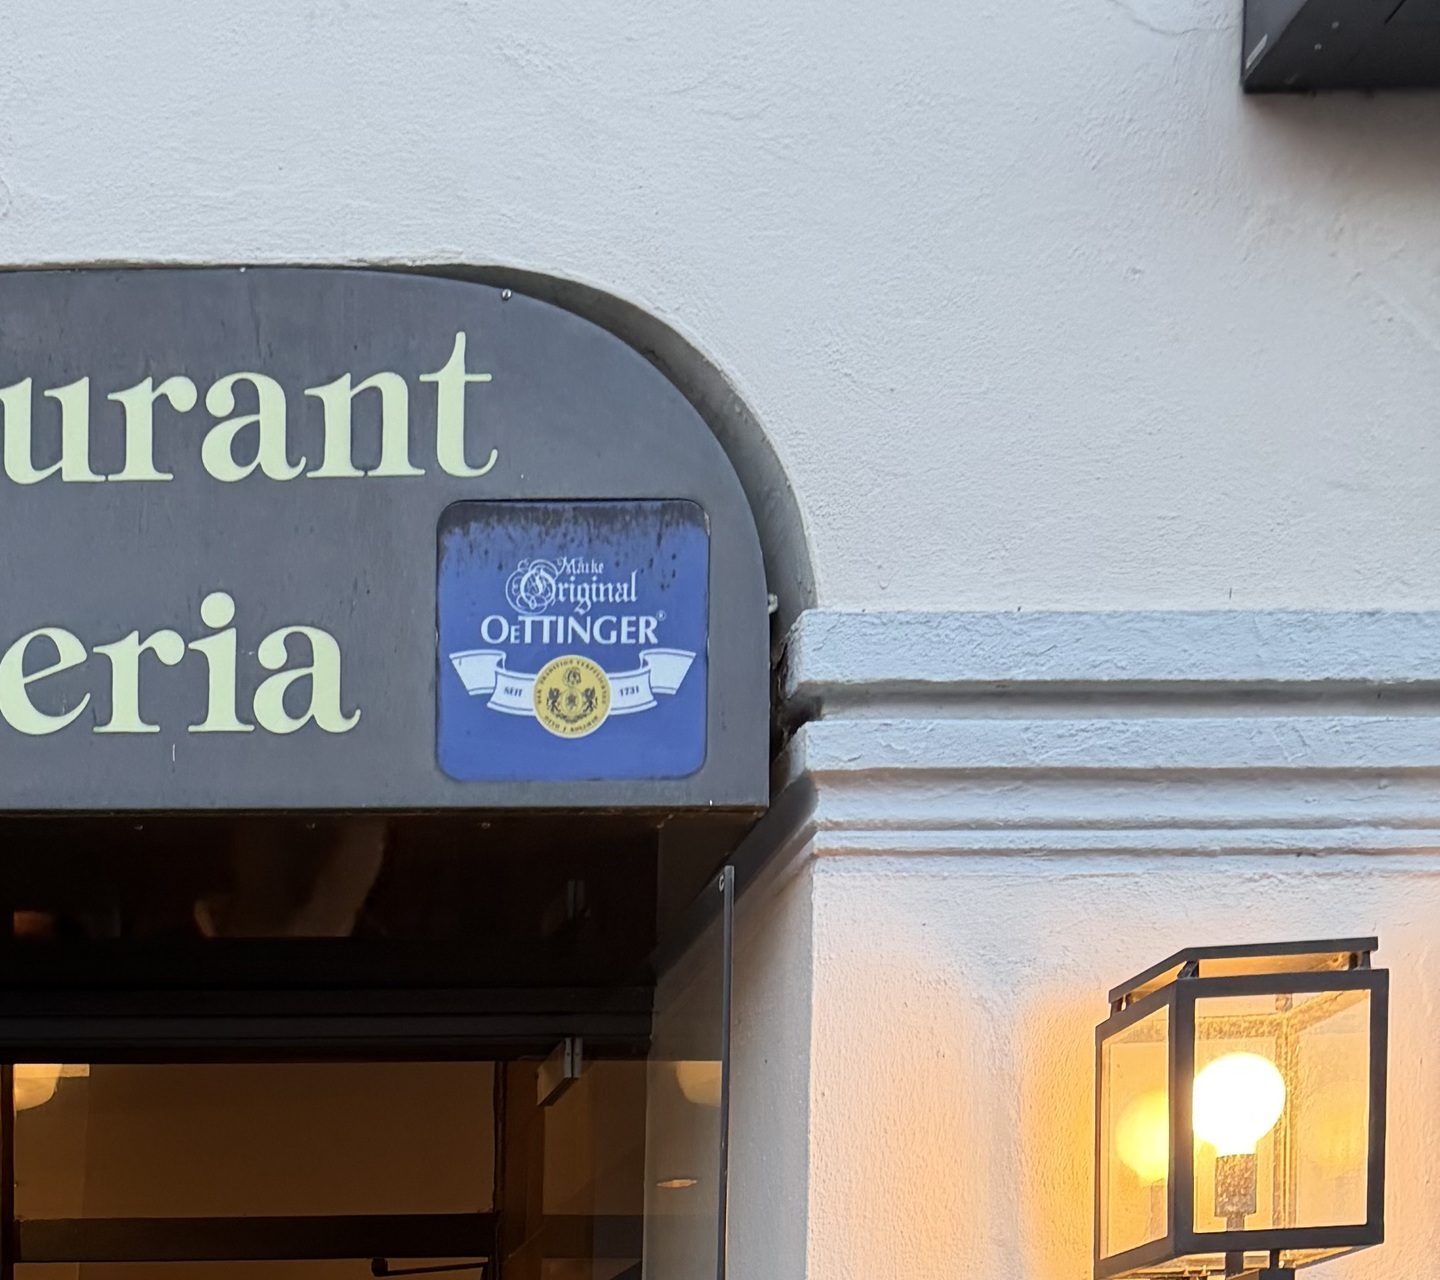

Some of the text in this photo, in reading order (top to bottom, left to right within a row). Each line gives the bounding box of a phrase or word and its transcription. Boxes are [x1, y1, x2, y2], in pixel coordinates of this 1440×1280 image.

[505, 558, 639, 616] Original
[504, 685, 640, 698] SEIT 1731
